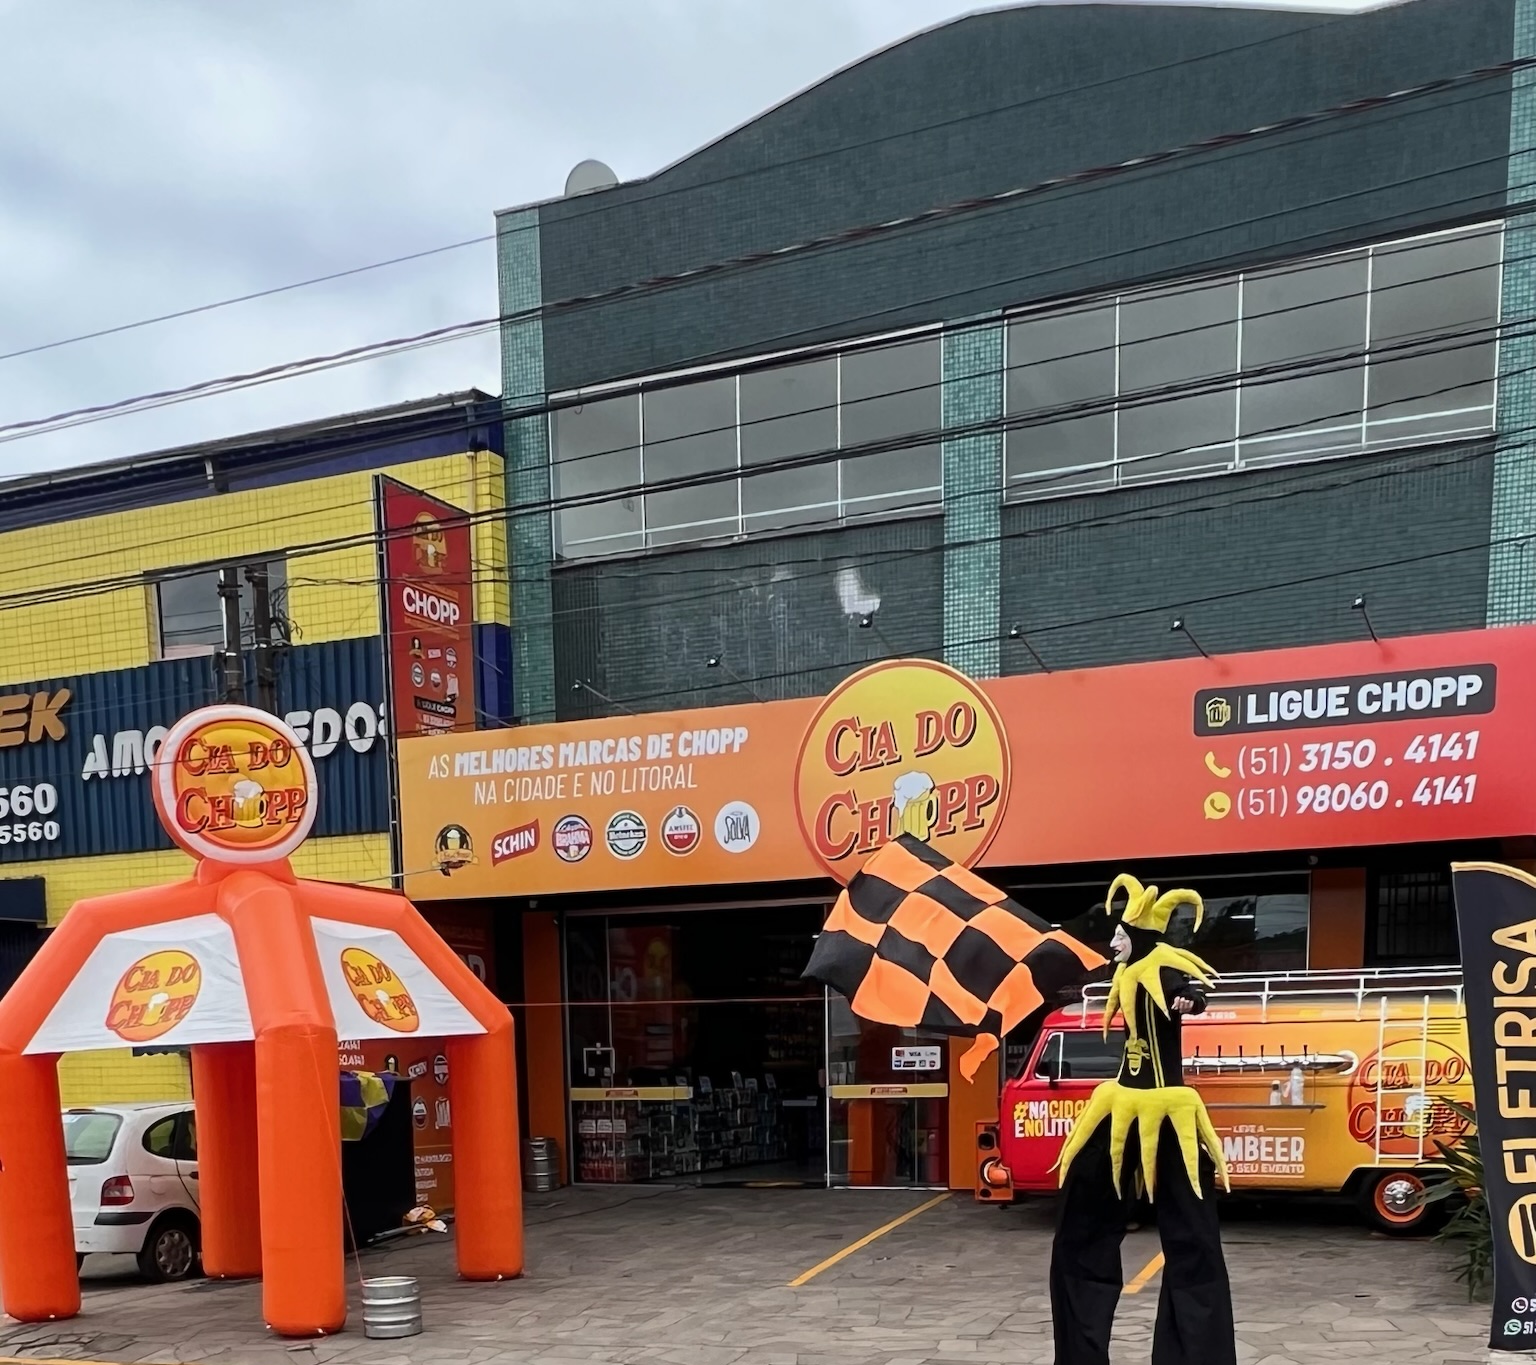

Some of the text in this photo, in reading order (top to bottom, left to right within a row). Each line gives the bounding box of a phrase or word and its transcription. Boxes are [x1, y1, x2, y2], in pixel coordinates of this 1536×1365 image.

[402, 586, 460, 625] CHOPP
[1246, 674, 1483, 724] LIGUE CHOPP
[180, 737, 292, 777] CIA DO
[428, 726, 748, 779] AS MELHORES MARCAS DE CHOPP
[824, 700, 978, 777] CIA DO
[1237, 742, 1291, 780] (51)
[1298, 738, 1376, 772] 3150
[1404, 730, 1481, 763] 4141
[474, 763, 698, 806] NA CIDADE E NO LITORAL
[1237, 785, 1289, 821] (51)
[1296, 780, 1389, 815] 98060
[1411, 773, 1478, 807] 4141
[175, 787, 307, 834] CHOPP
[814, 773, 1001, 861] CHOPP
[493, 828, 536, 859] SCHIN
[166, 962, 198, 987] DO
[1222, 1135, 1305, 1162] MBEER
